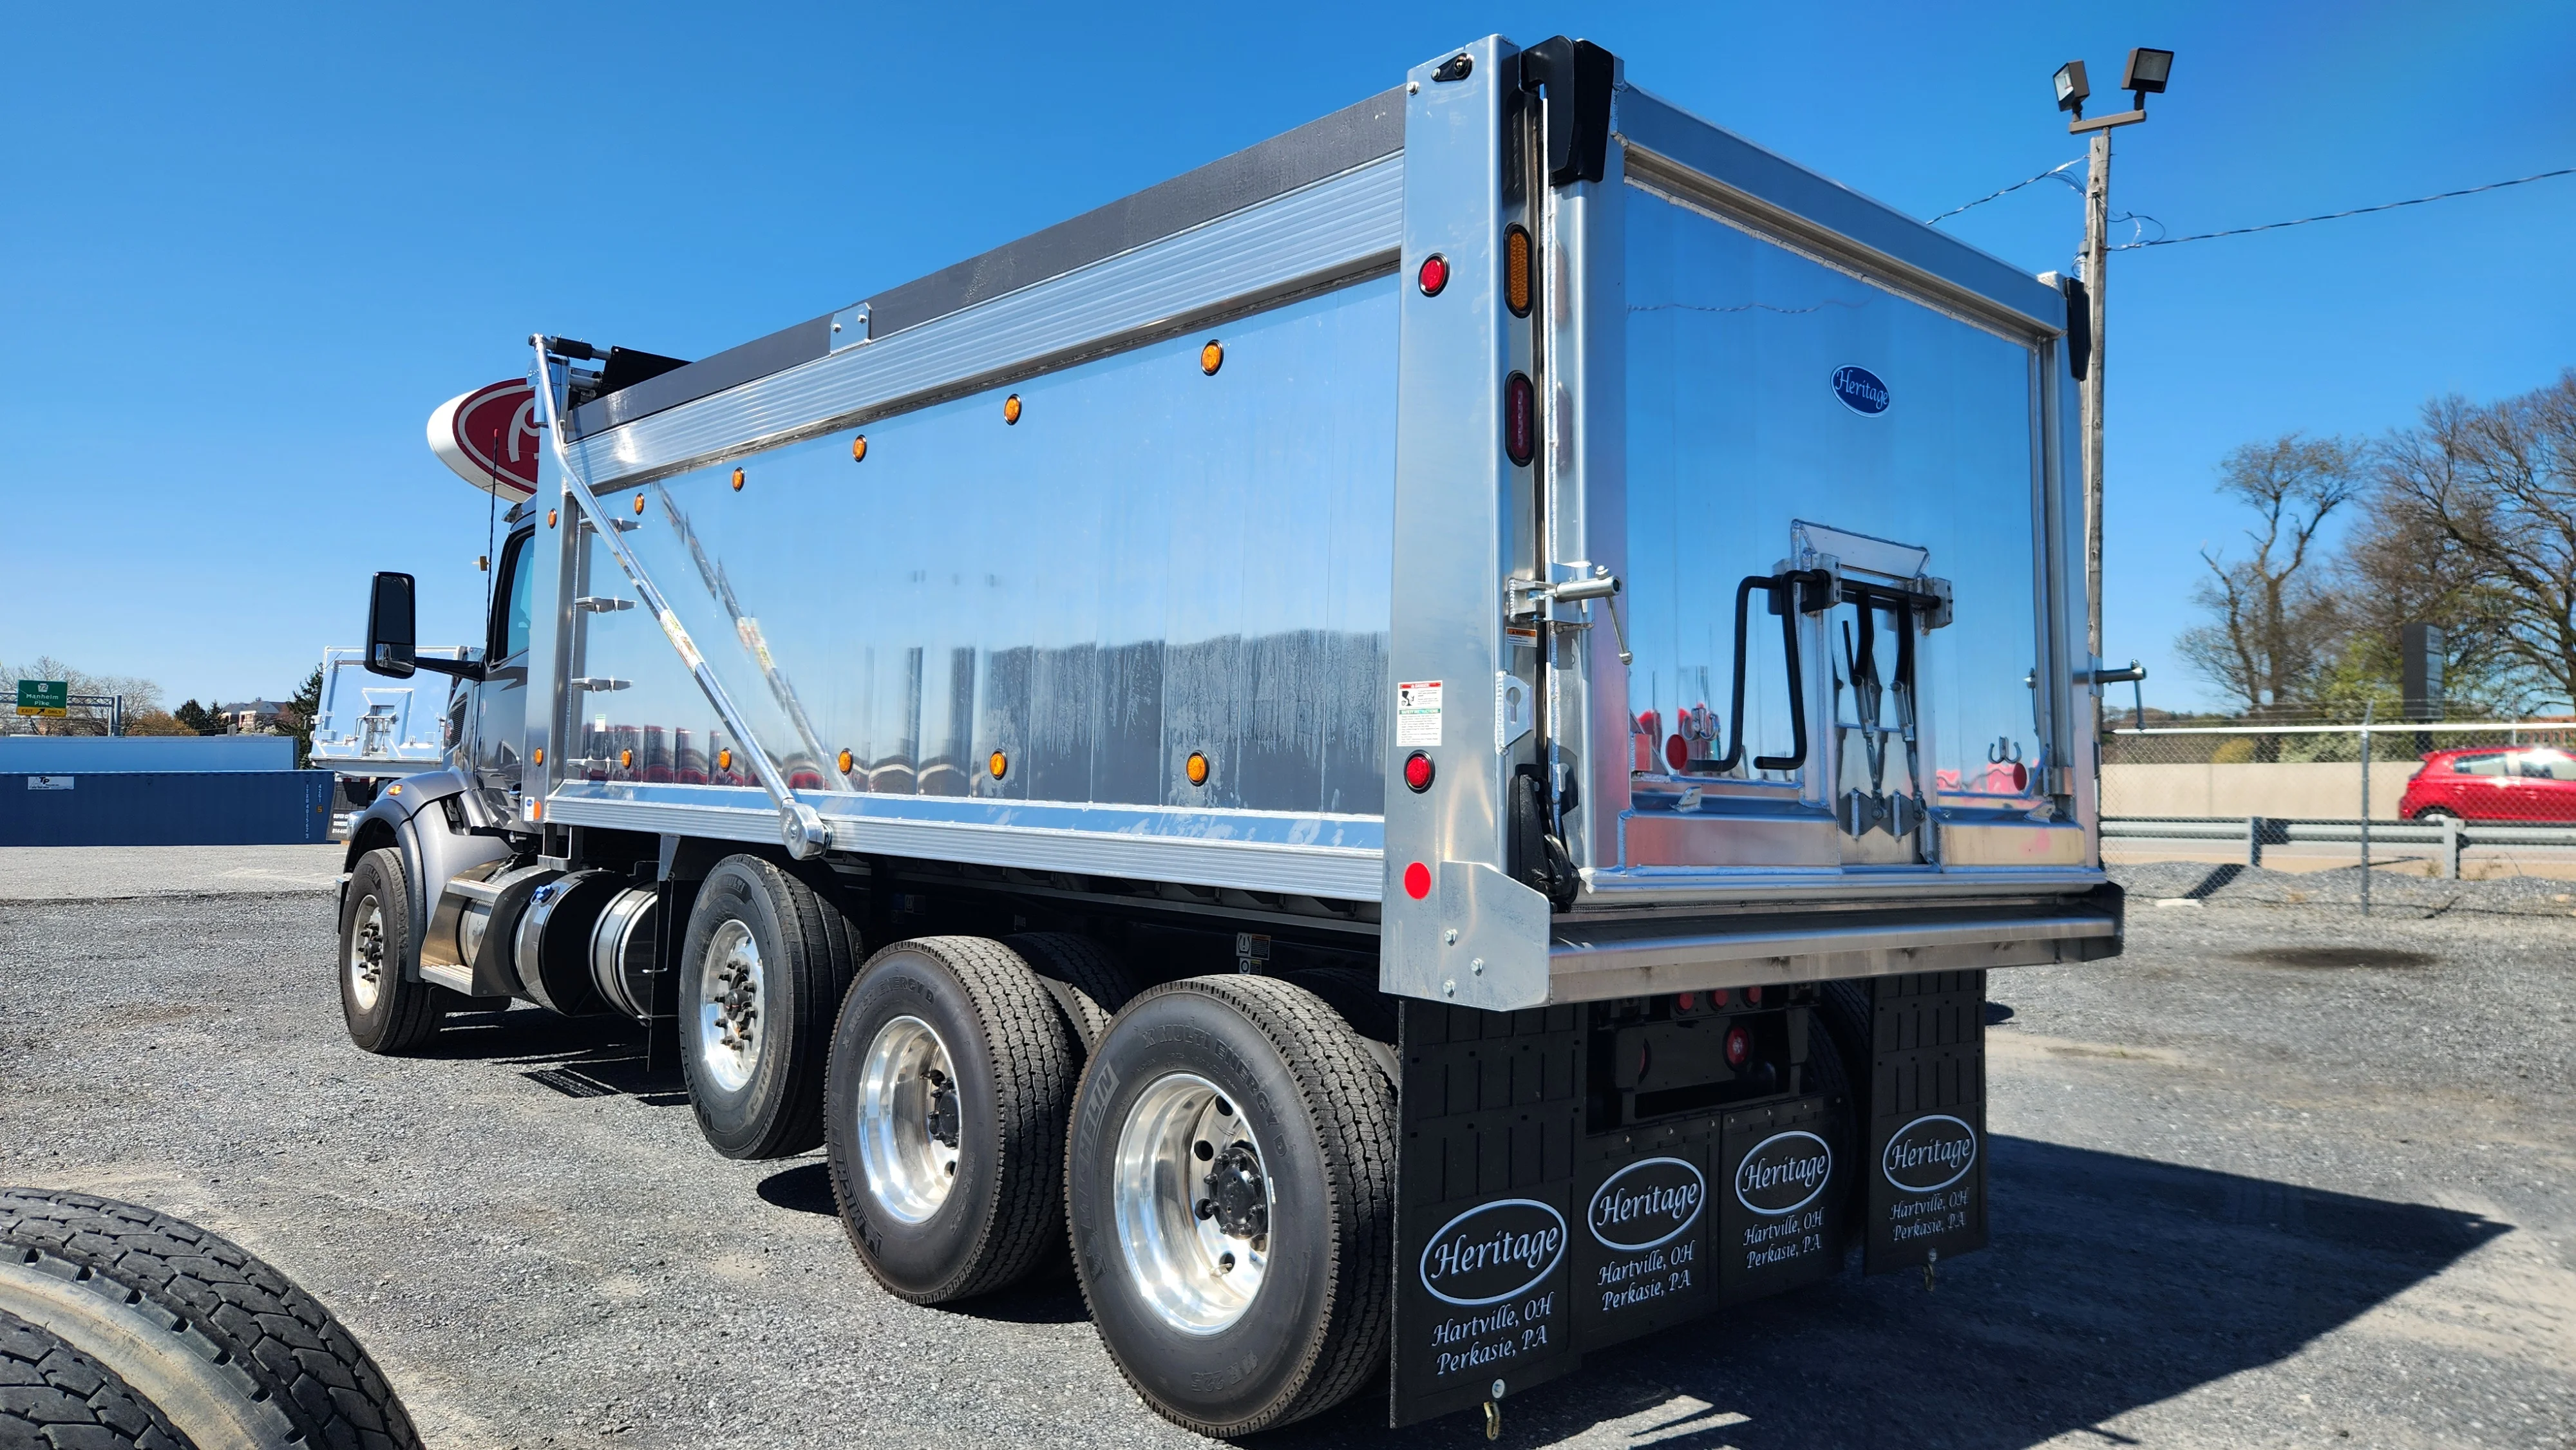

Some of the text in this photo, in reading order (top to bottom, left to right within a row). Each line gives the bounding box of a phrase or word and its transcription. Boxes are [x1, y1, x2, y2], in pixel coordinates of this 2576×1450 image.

[1835, 369, 1888, 410] Heritage
[878, 975, 925, 997] ENERGY
[1159, 1024, 1211, 1050] MULTI
[1214, 1038, 1280, 1127] ENERGY
[1273, 1132, 1287, 1156] D
[831, 1093, 866, 1229] MICHELIN
[1077, 1064, 1117, 1230] MICHELIN
[1889, 1138, 1971, 1171] Heritage
[1742, 1154, 1826, 1192] Heritage
[1596, 1182, 1698, 1227] Heritage
[1889, 1187, 1971, 1220] Hartville, OH
[1743, 1207, 1824, 1247] Hartville, OH
[1893, 1211, 1966, 1241] Perkasie, PA
[1430, 1226, 1558, 1279] Heritage
[1597, 1239, 1696, 1286] Hartville, OH
[1746, 1233, 1822, 1268] Perkasie, PA
[1602, 1269, 1692, 1311] Perkasie, PA
[1431, 1291, 1555, 1347] Hartville, OH
[1436, 1324, 1548, 1375] Perkasie, PA
